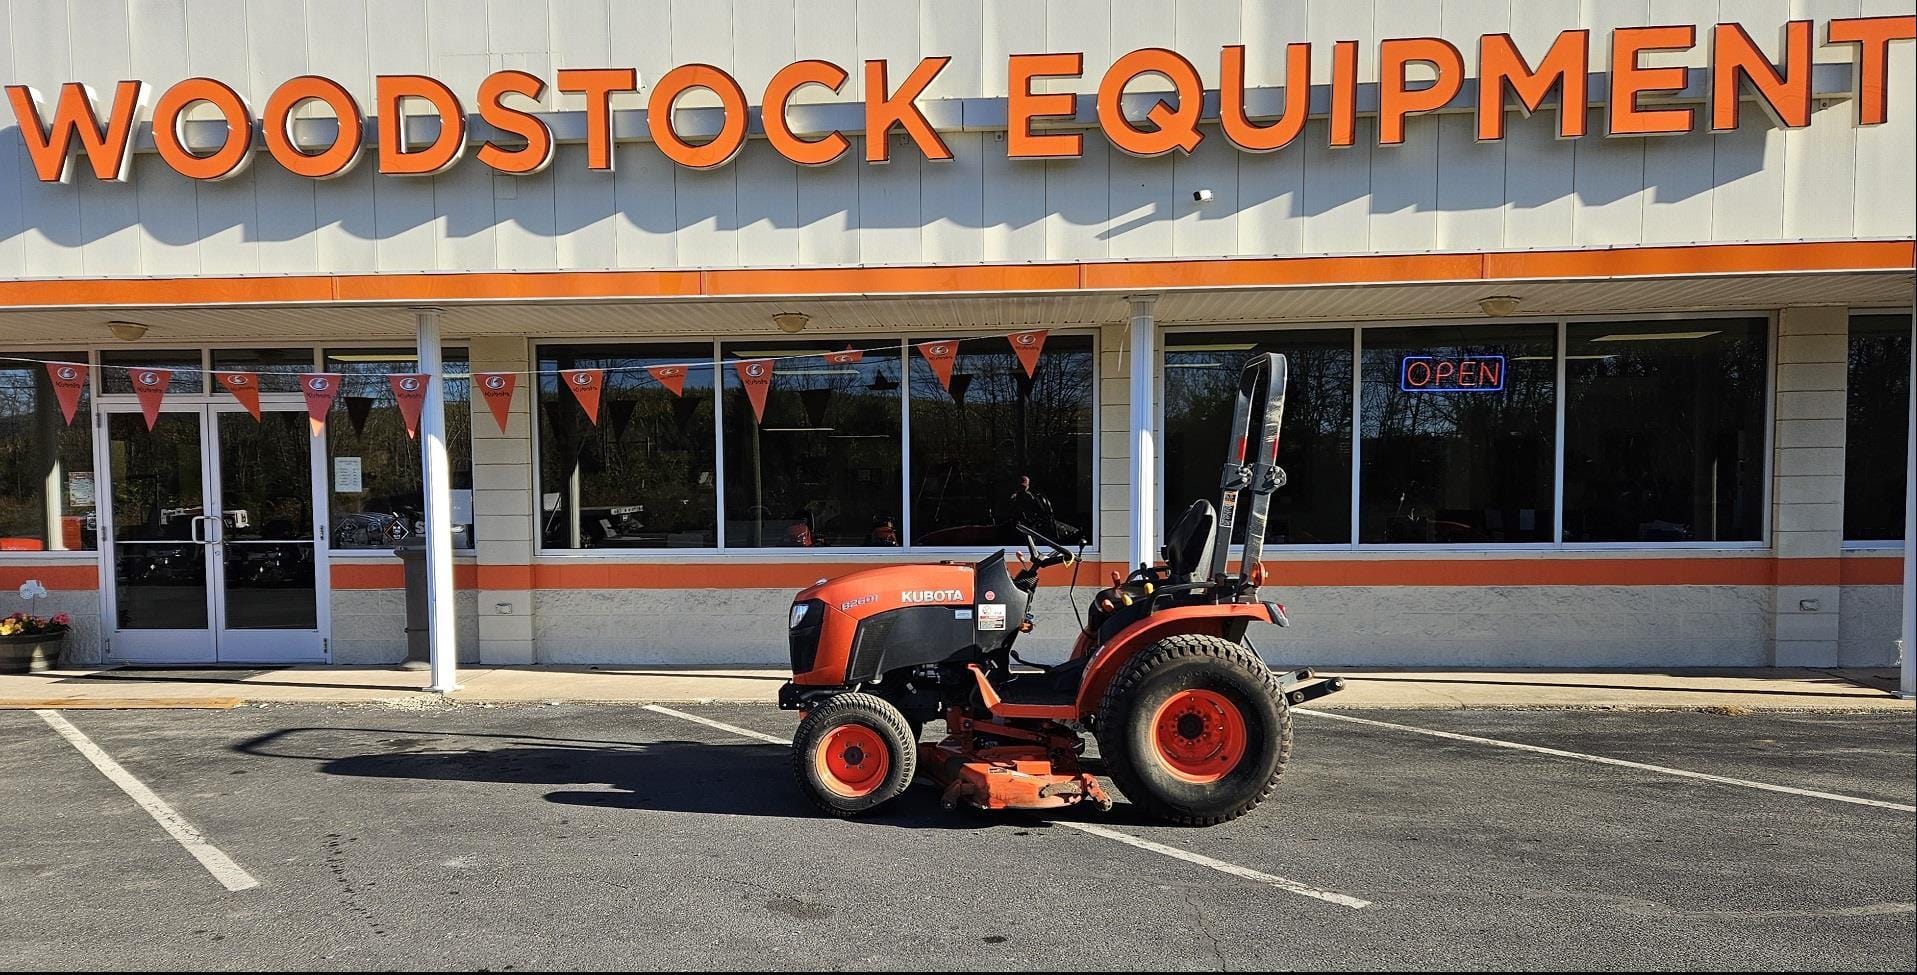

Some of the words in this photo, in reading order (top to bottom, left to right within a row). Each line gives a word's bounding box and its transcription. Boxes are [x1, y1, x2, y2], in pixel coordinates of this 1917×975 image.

[4, 56, 955, 183] WOODSTOCK
[1007, 15, 1916, 159] EQUIPMENT
[1407, 361, 1500, 386] OPEN
[841, 594, 879, 611] B2601
[901, 590, 964, 603] KUBOTA
